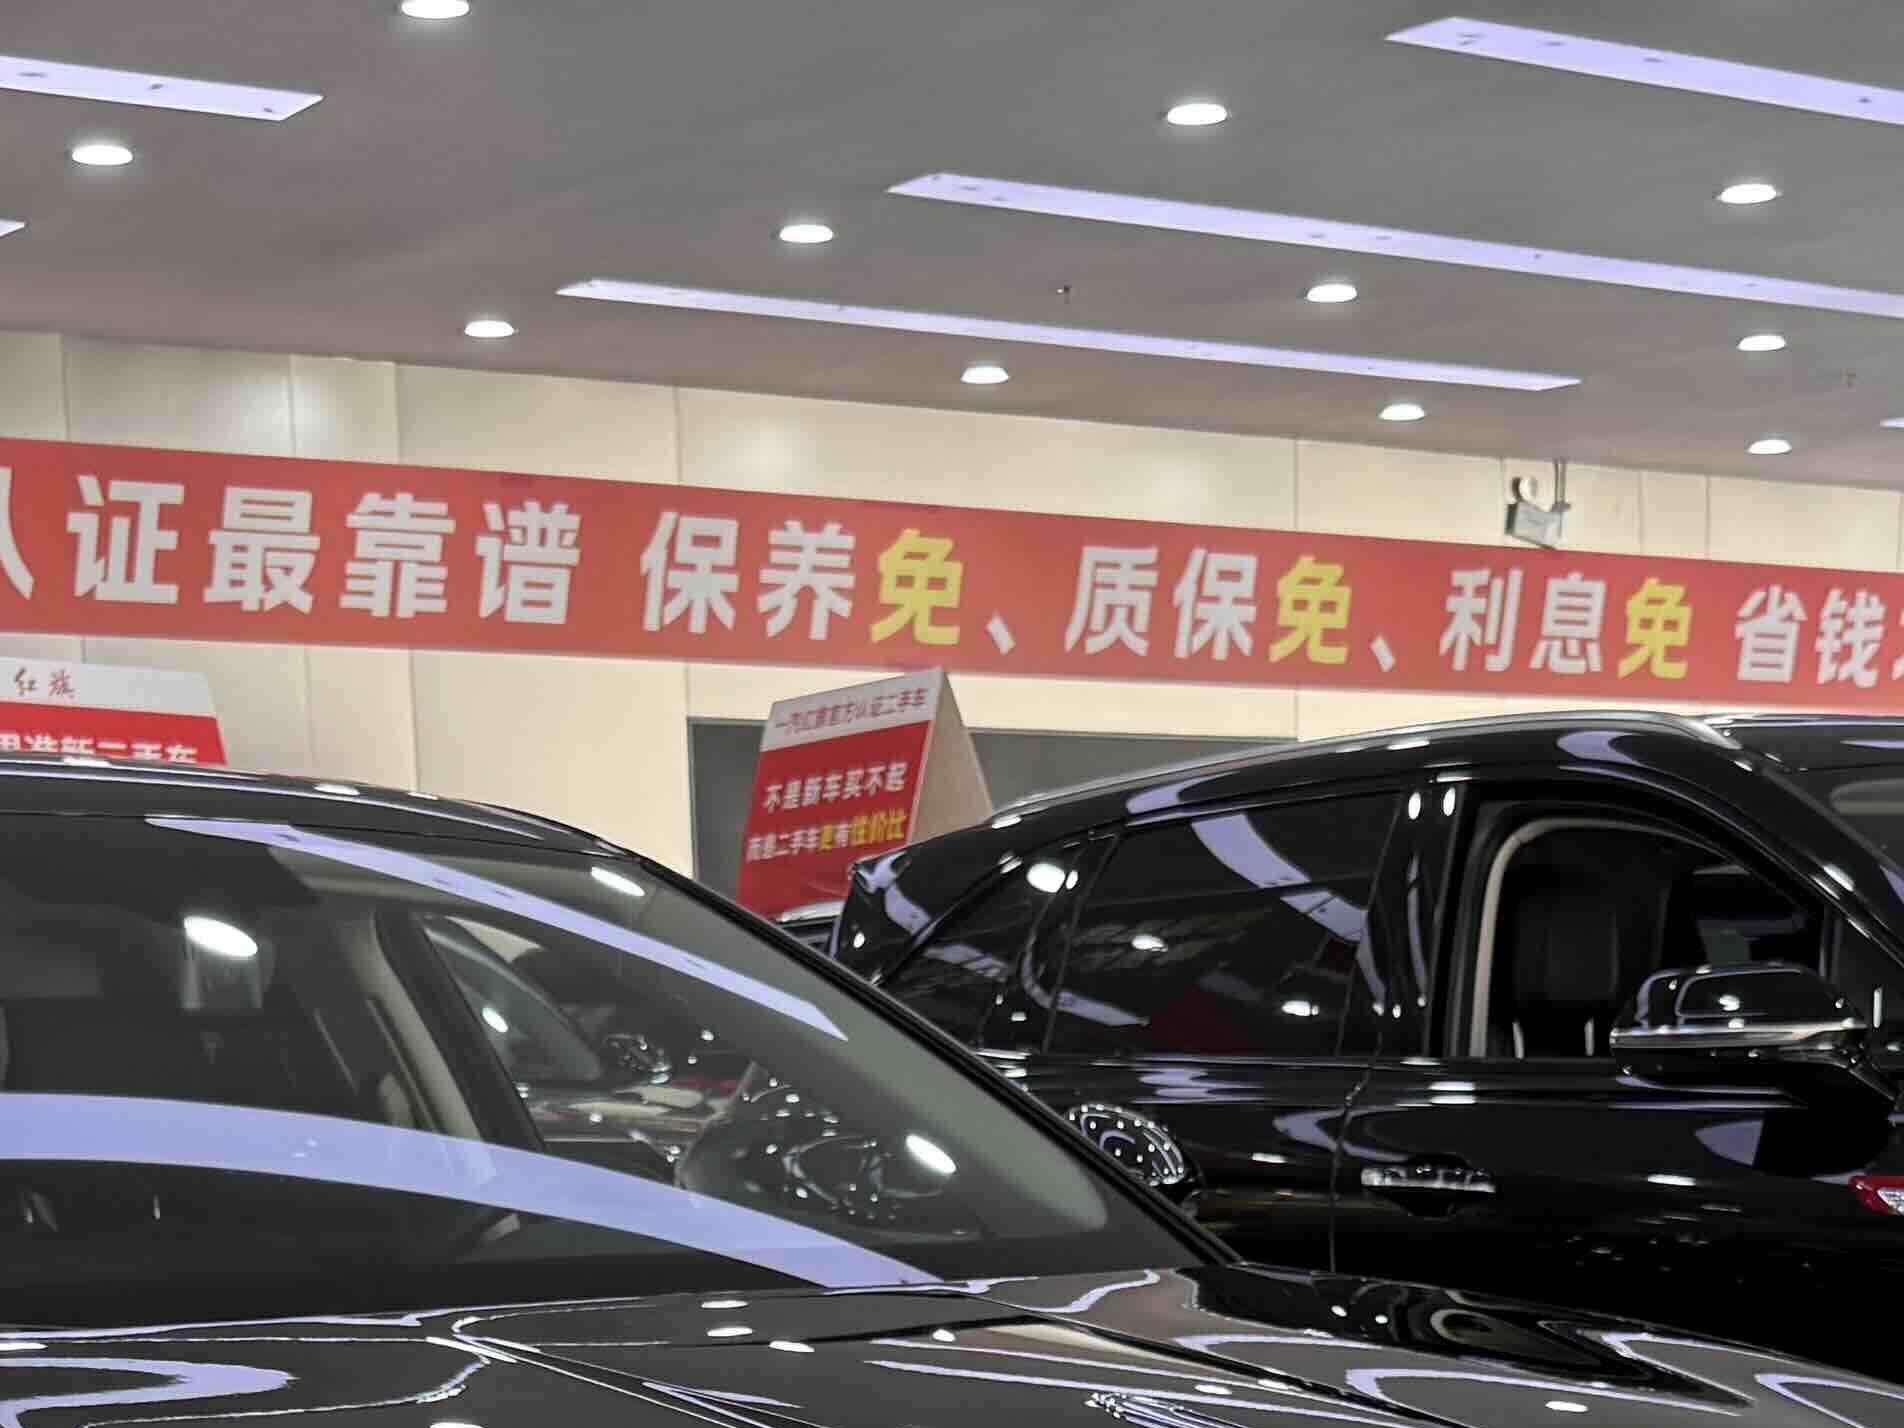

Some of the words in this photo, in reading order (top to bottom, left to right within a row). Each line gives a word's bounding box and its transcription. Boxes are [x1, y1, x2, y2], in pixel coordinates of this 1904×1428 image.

[639, 509, 1694, 681] 保养免、质保免、利息免
[12, 666, 76, 699] 红旗
[762, 761, 909, 814] 不是新车买不起
